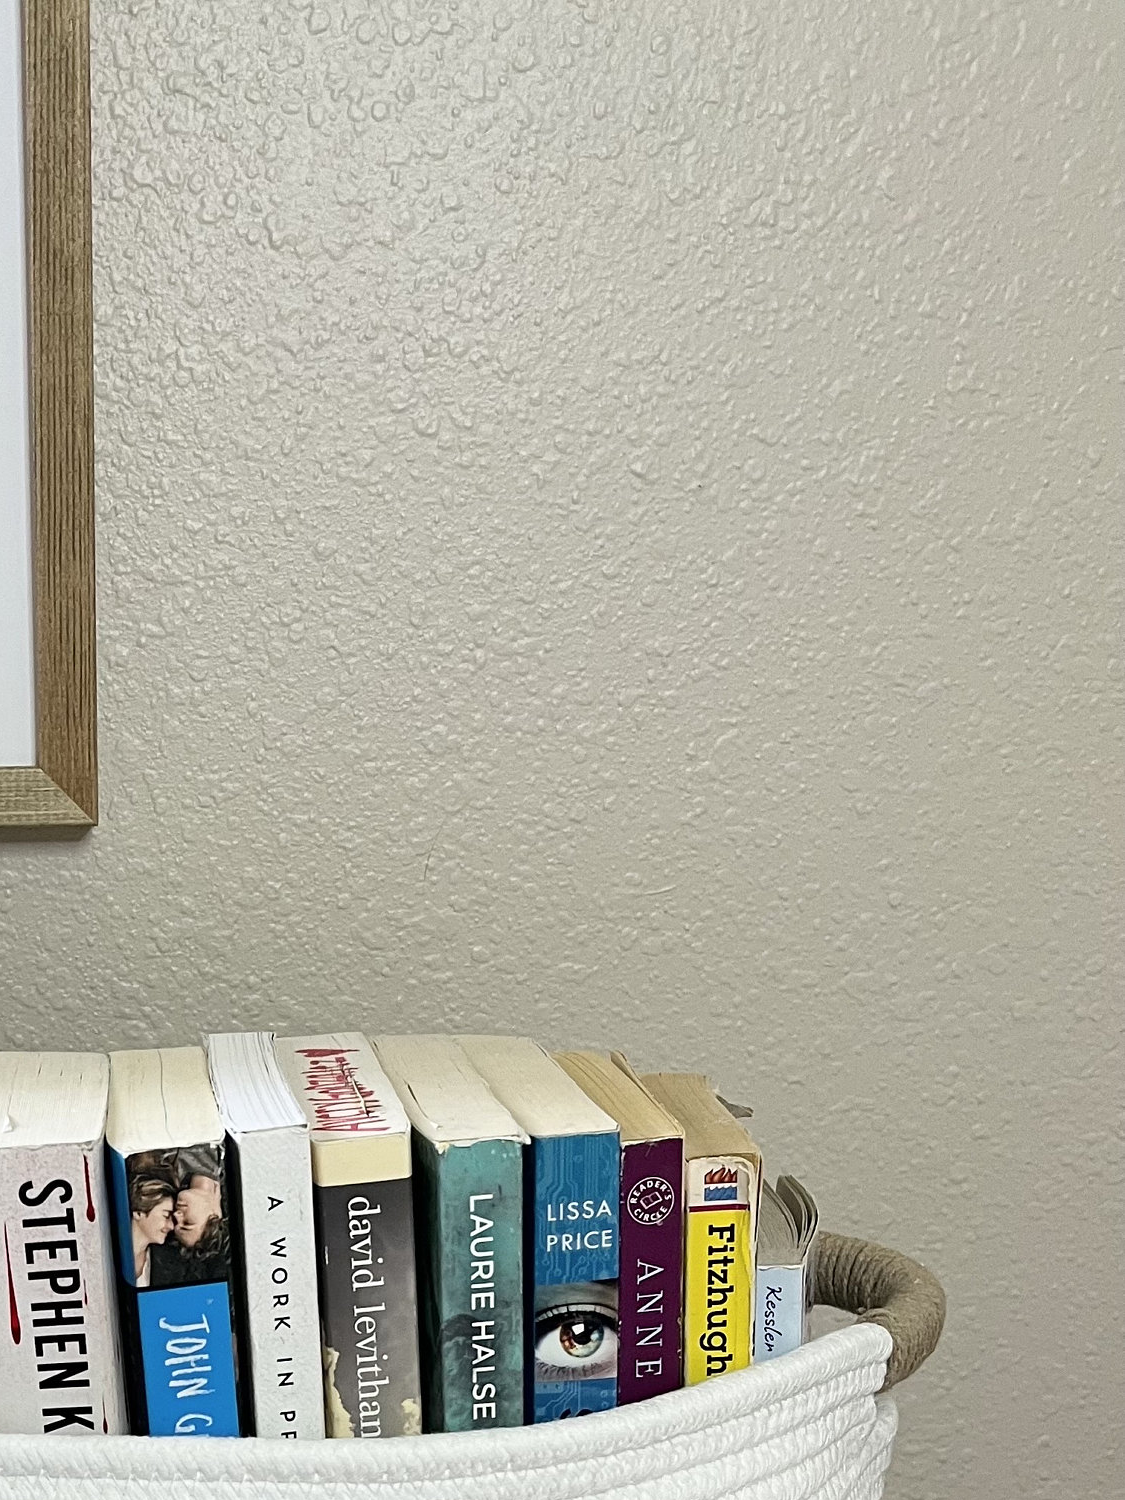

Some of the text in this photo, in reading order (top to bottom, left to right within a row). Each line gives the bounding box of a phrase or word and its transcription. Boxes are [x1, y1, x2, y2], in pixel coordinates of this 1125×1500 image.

[267, 1195, 285, 1212] A
[547, 1200, 613, 1222] LISSA
[630, 1180, 672, 1204] READER'S
[633, 1205, 668, 1222] CIRCLE
[18, 1179, 91, 1391] STEPHEN
[270, 1236, 292, 1330] WORK
[546, 1230, 613, 1252] PRICE
[347, 1196, 391, 1438] david levithan
[469, 1193, 497, 1422] LAURIE HALSE
[636, 1259, 664, 1379] ANNE
[699, 1222, 736, 1377] Fitzhugh
[159, 1314, 216, 1437] JOHN G
[277, 1358, 295, 1387] IN
